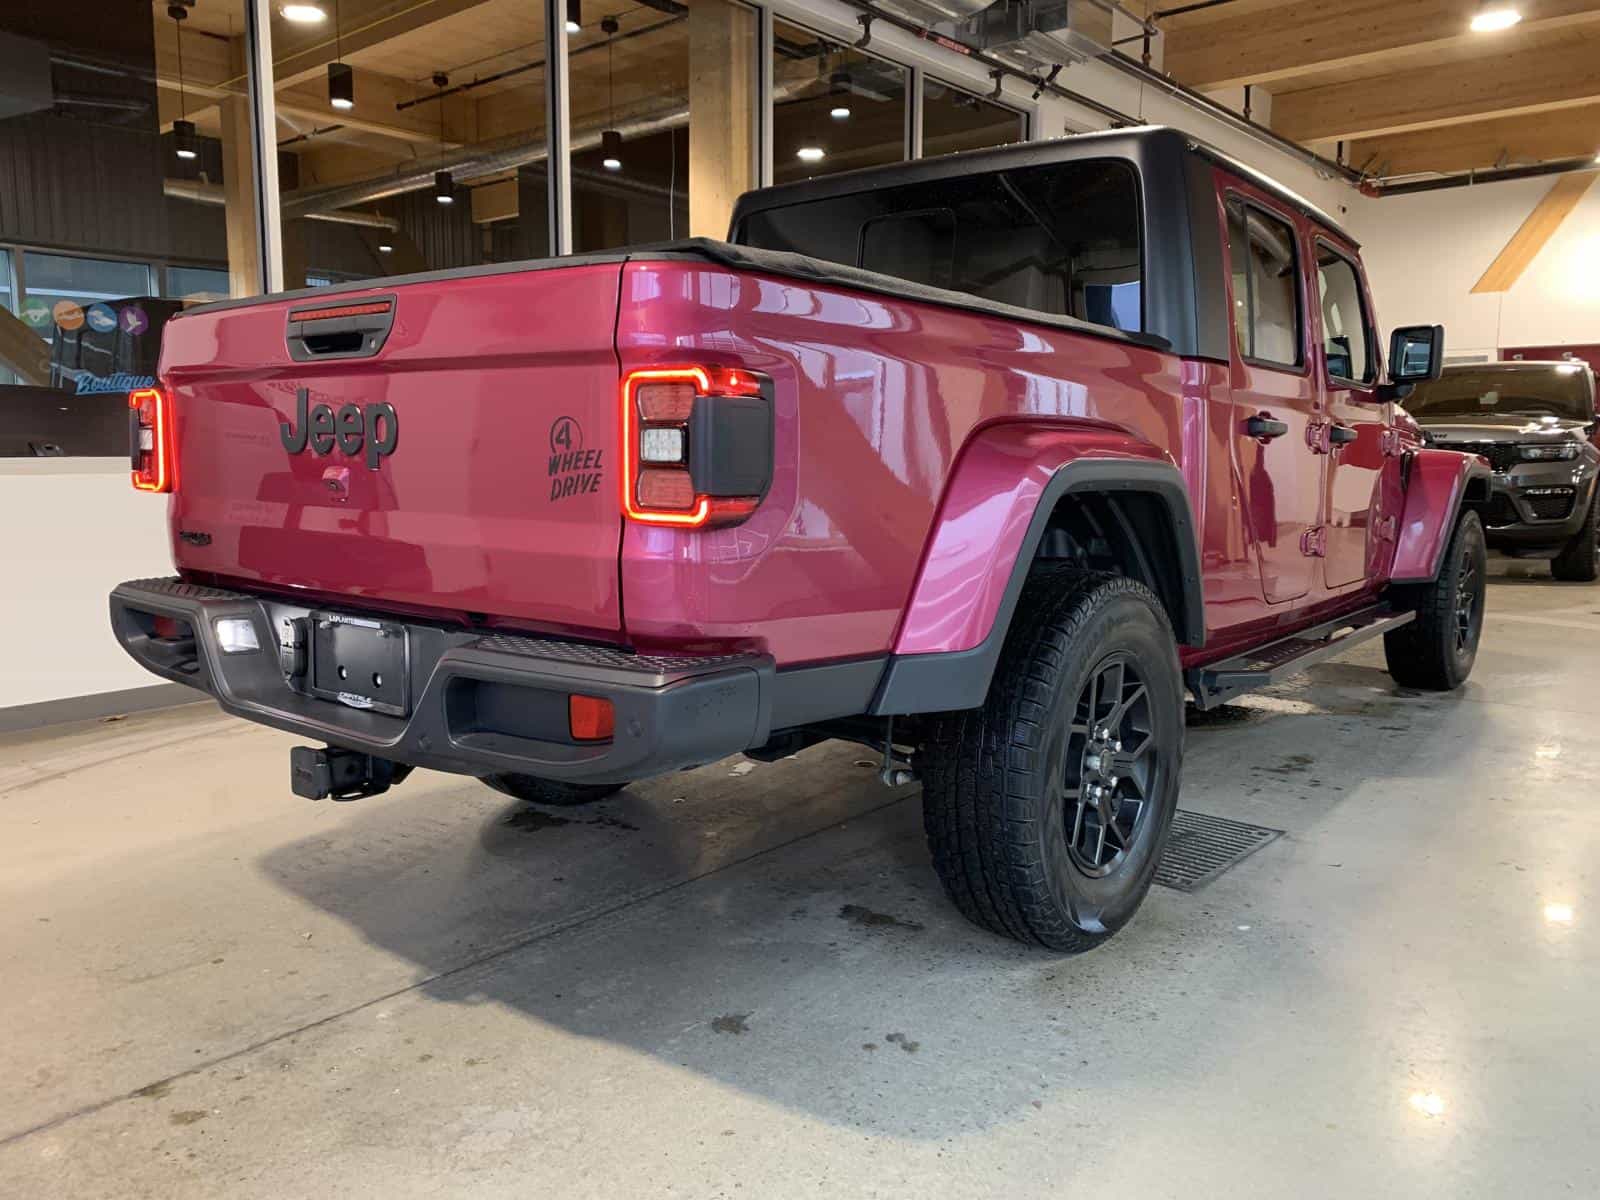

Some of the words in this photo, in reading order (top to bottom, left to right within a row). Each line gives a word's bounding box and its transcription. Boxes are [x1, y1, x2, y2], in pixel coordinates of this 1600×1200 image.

[75, 372, 155, 394] Boutique
[279, 387, 399, 471] Jeep
[555, 421, 571, 450] 4
[548, 449, 603, 476] WHEEL
[550, 473, 603, 502] DRIVE
